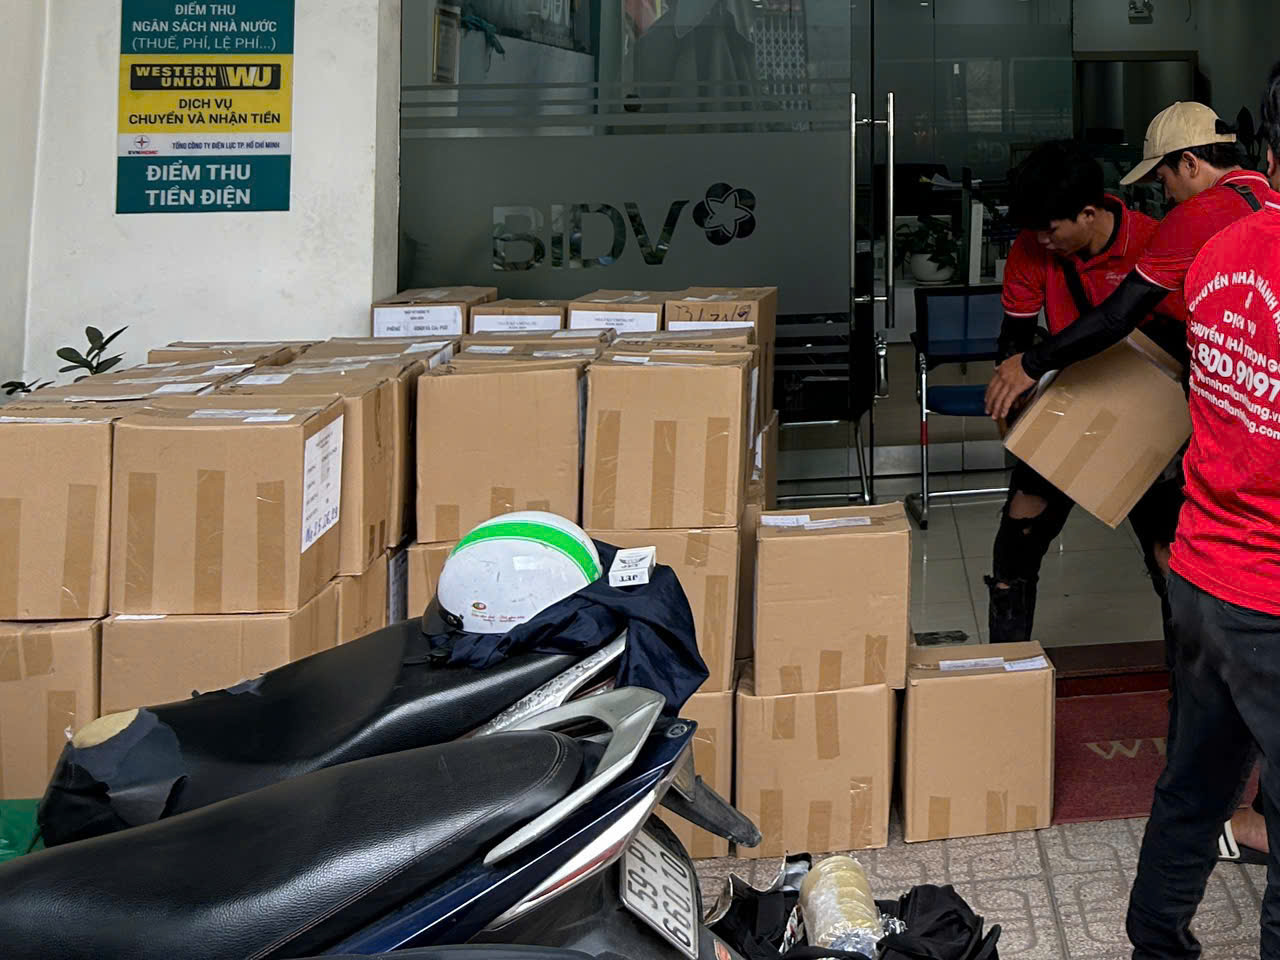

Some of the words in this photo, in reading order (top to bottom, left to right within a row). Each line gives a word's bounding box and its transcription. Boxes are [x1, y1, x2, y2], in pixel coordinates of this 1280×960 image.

[175, 1, 207, 16] ĐIỂM
[210, 4, 236, 16] THU
[132, 19, 169, 32] NGÂN
[172, 19, 206, 32] SÁCH
[209, 19, 238, 32] NHÀ
[241, 18, 277, 32] NƯỚC
[132, 34, 179, 51] (THUẾ,
[182, 35, 211, 50] PHÍ,
[214, 36, 232, 52] LỆ
[235, 35, 276, 51] PHÍ...)
[135, 66, 217, 77] WESTERN
[225, 66, 272, 87] WU
[161, 77, 217, 87] UNION
[179, 98, 210, 110] DỊCH
[214, 98, 233, 111] VỤ
[128, 110, 184, 125] CHUYỂN
[187, 111, 206, 124] VÀ
[209, 112, 248, 127] NHẬN
[251, 109, 281, 124] TIỀN
[146, 159, 201, 181] ĐIỂM
[206, 164, 251, 180] THU
[145, 184, 195, 206] TIỀN
[200, 184, 251, 208] ĐIỆN
[492, 200, 690, 272] BIDV
